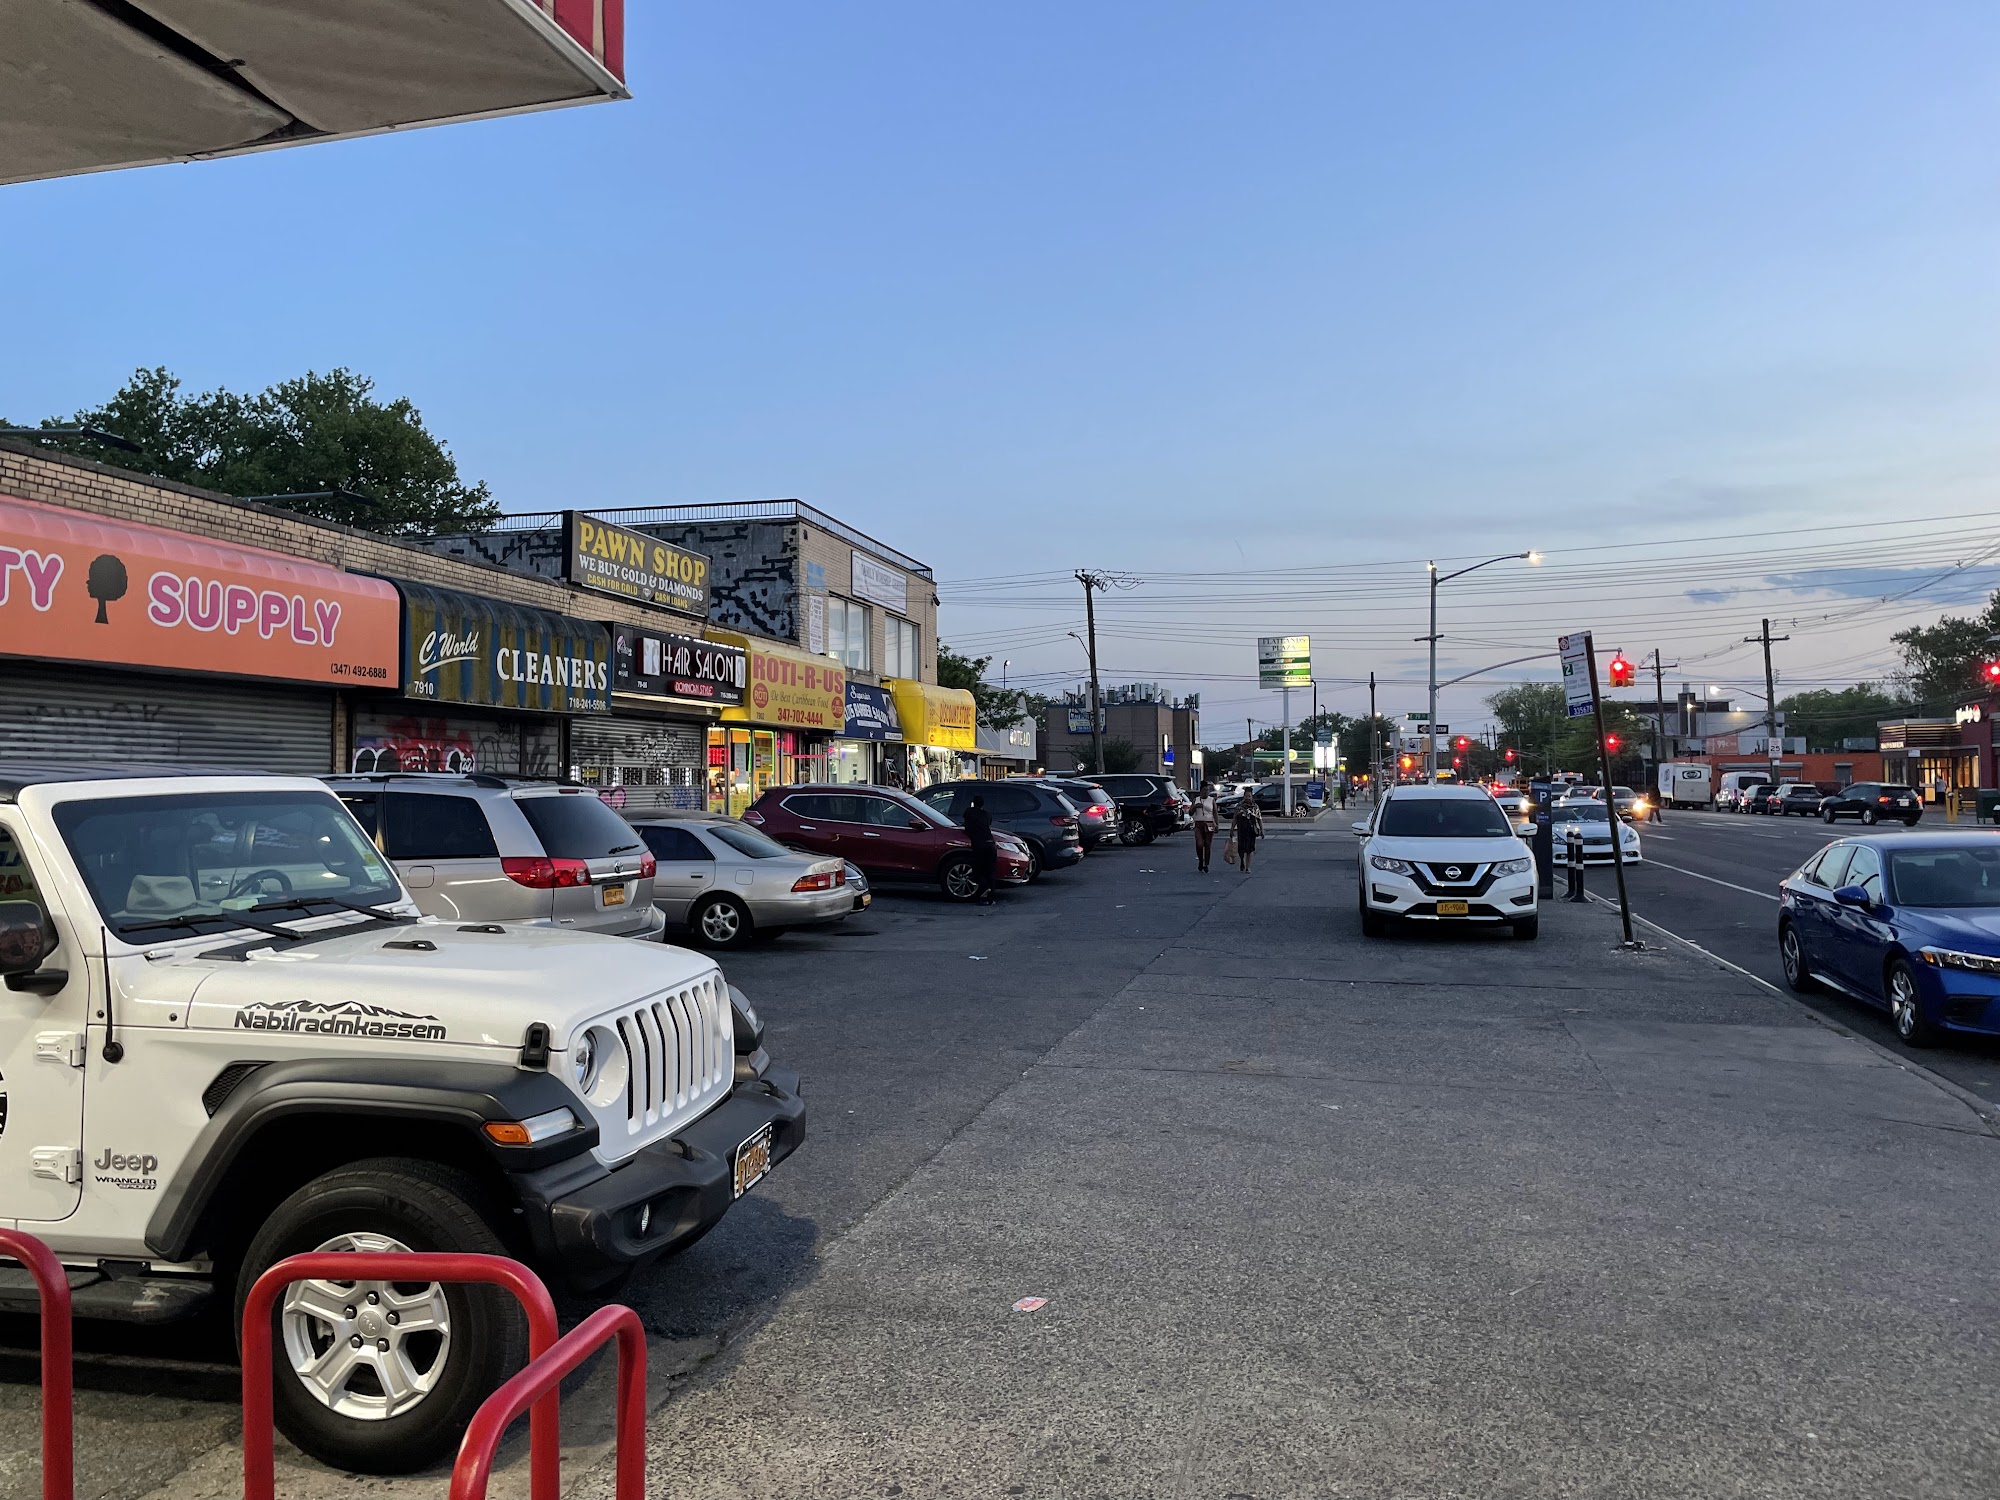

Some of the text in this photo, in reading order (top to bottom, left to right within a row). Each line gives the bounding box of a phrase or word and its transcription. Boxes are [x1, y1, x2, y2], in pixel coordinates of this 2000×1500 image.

[579, 521, 705, 586] PAWN SHOP
[579, 554, 704, 601] WE BUY GOLD & DIAMONDS
[587, 573, 638, 596] CASH FOR GOLD
[148, 571, 341, 648] SUPPLY
[654, 592, 688, 609] CASH LOANS
[419, 631, 479, 665] C. World
[1262, 637, 1306, 645] FLATLANDS
[330, 662, 388, 680] (347) 492-6888
[497, 647, 607, 691] CLEANERS
[662, 642, 691, 676] HAIR
[695, 648, 734, 682] SALON
[753, 653, 844, 695] ROTI-R-US
[414, 681, 434, 696] 7910
[777, 707, 823, 725] 347-702-4444
[1540, 791, 1548, 803] P
[233, 1010, 448, 1040] Nabilradmkassem
[94, 1147, 158, 1175] Jeep
[95, 1175, 157, 1185] WRANGLER
